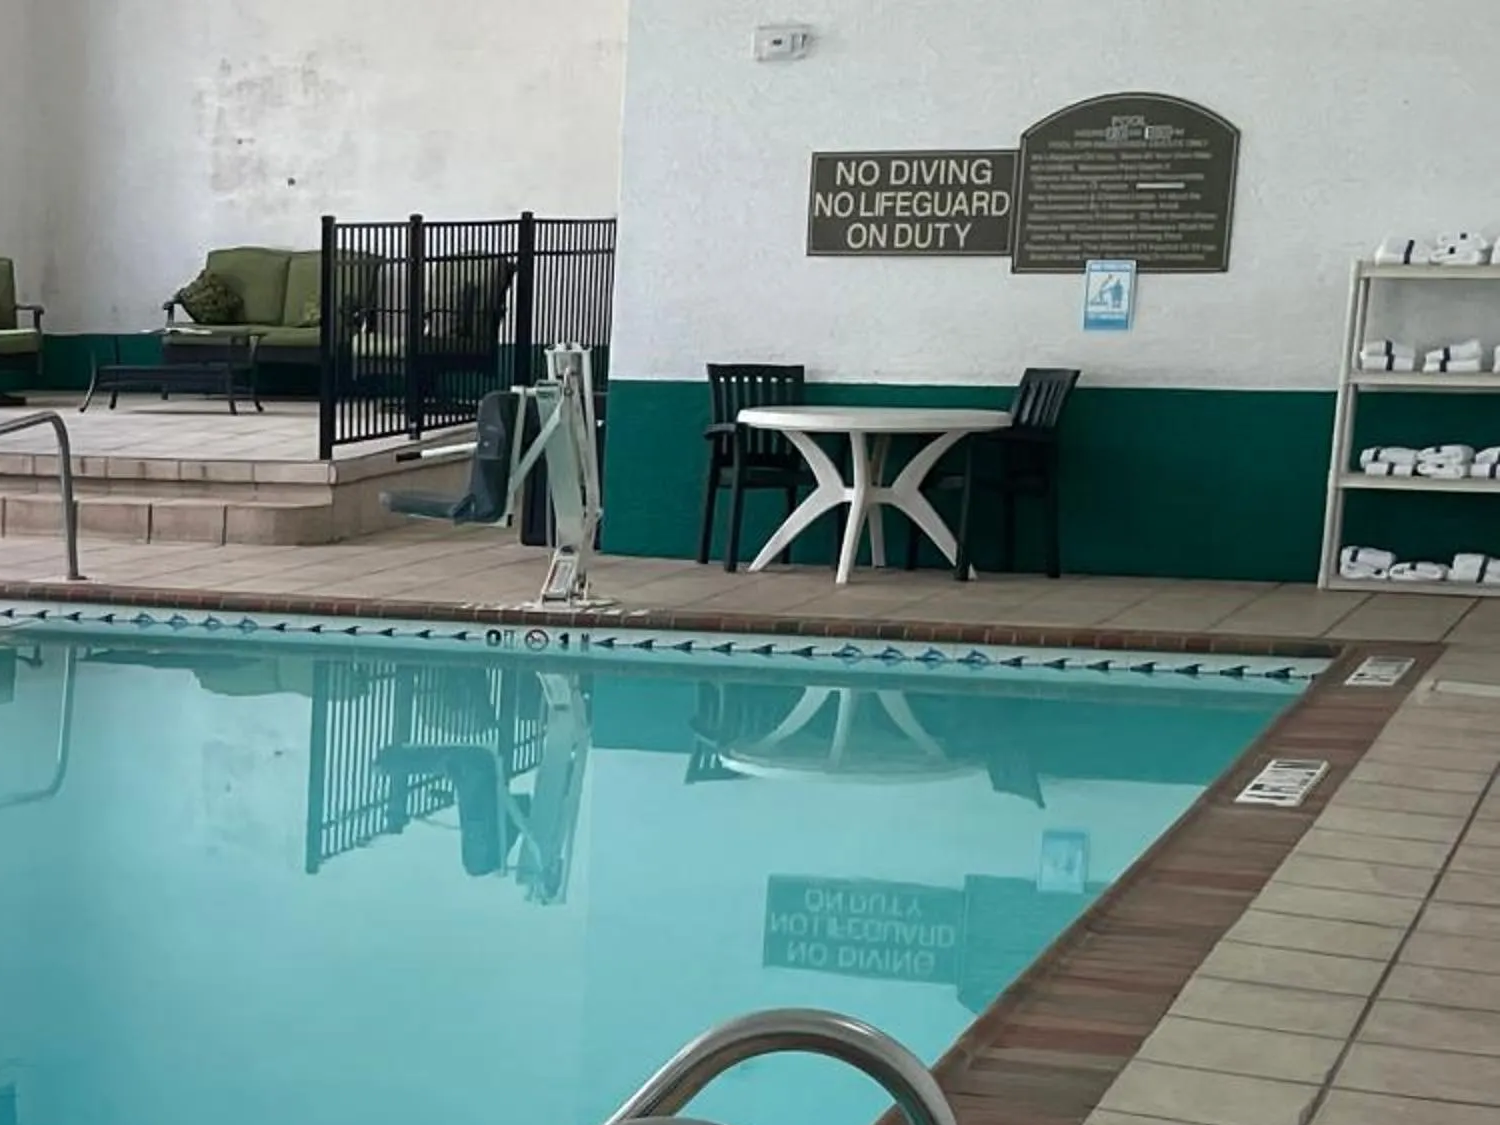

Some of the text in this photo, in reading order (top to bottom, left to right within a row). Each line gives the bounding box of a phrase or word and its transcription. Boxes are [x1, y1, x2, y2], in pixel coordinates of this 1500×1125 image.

[835, 159, 993, 186] NO DIVING
[814, 191, 1010, 218] NO LIFEGUARD
[847, 223, 972, 249] ON DUTY
